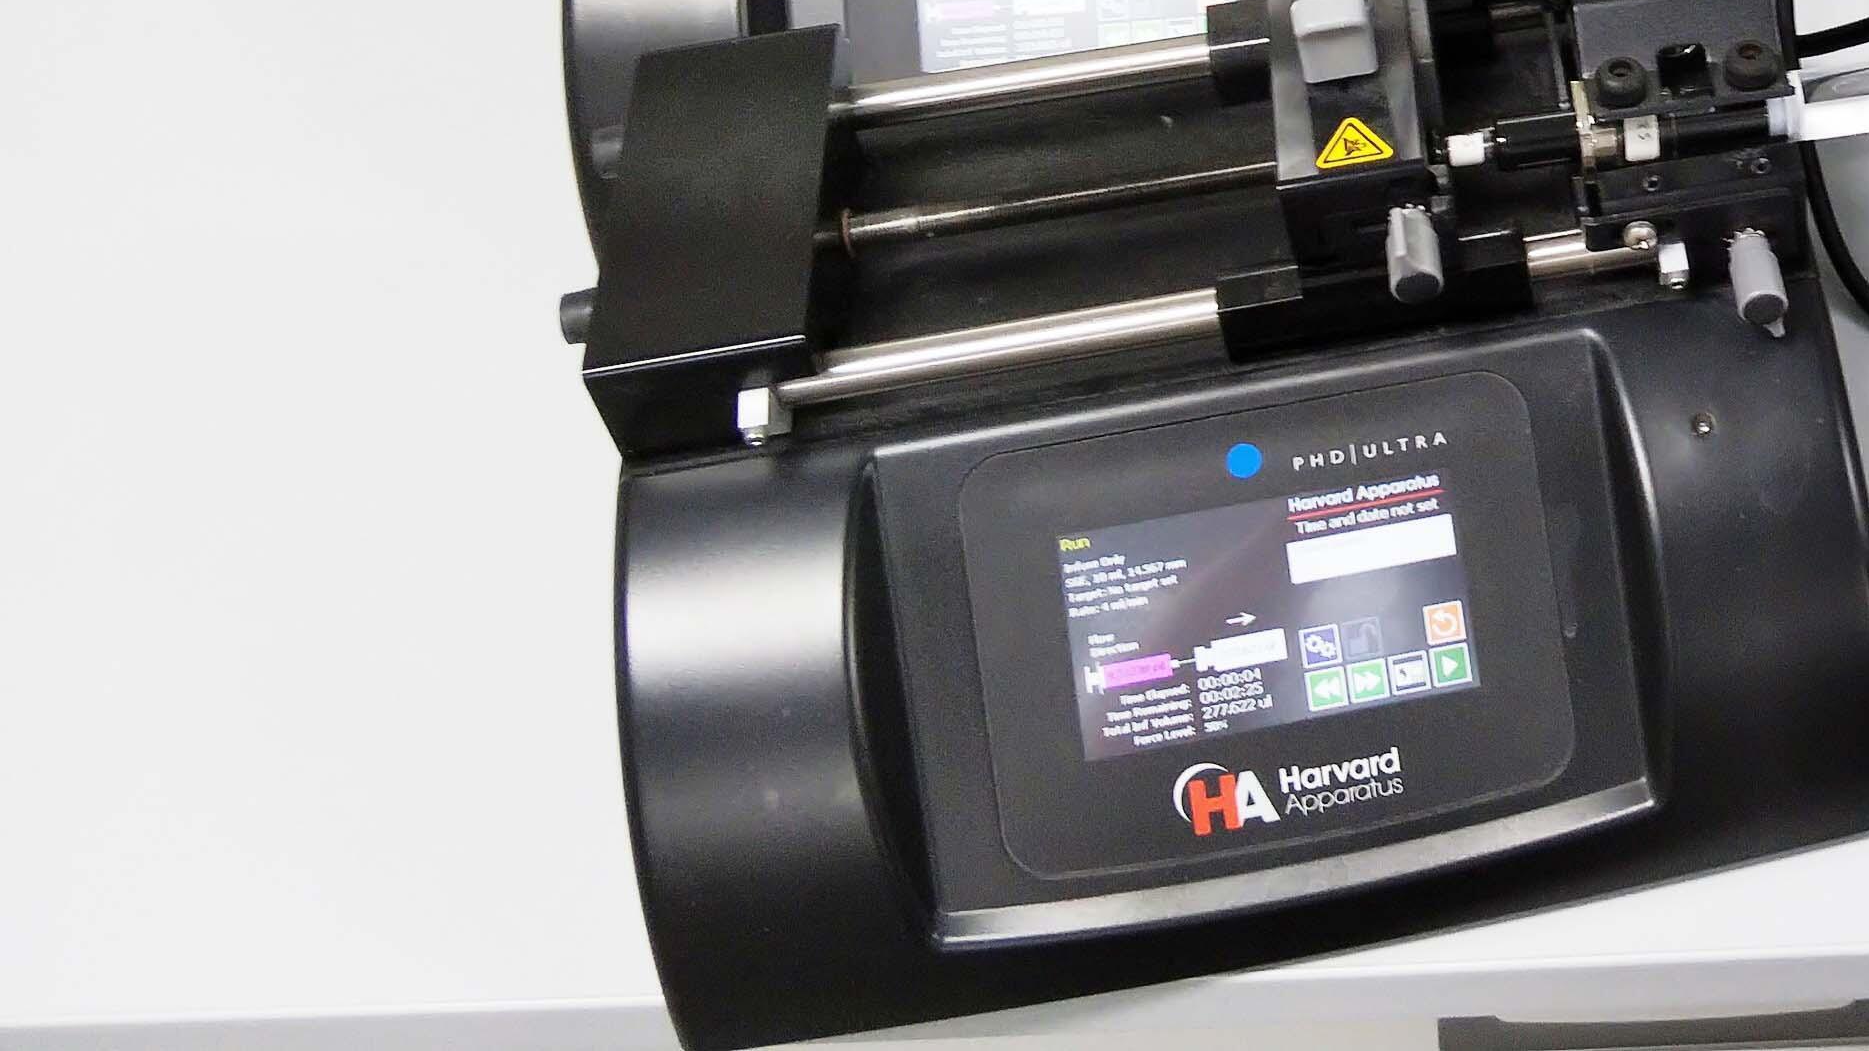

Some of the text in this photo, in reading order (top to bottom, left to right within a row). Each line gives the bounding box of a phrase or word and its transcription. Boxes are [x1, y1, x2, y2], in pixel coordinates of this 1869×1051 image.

[1287, 474, 1440, 513] Harvard Apparatus
[1328, 512, 1357, 529] and
[1356, 507, 1391, 524] date
[1390, 501, 1415, 517] not
[1416, 497, 1440, 512] set
[1059, 536, 1092, 552] Run
[1197, 667, 1262, 691] 00:00:04
[1198, 681, 1265, 705] 00:02:25
[1278, 746, 1402, 794] Harvard
[1284, 777, 1404, 816] Apparatus
